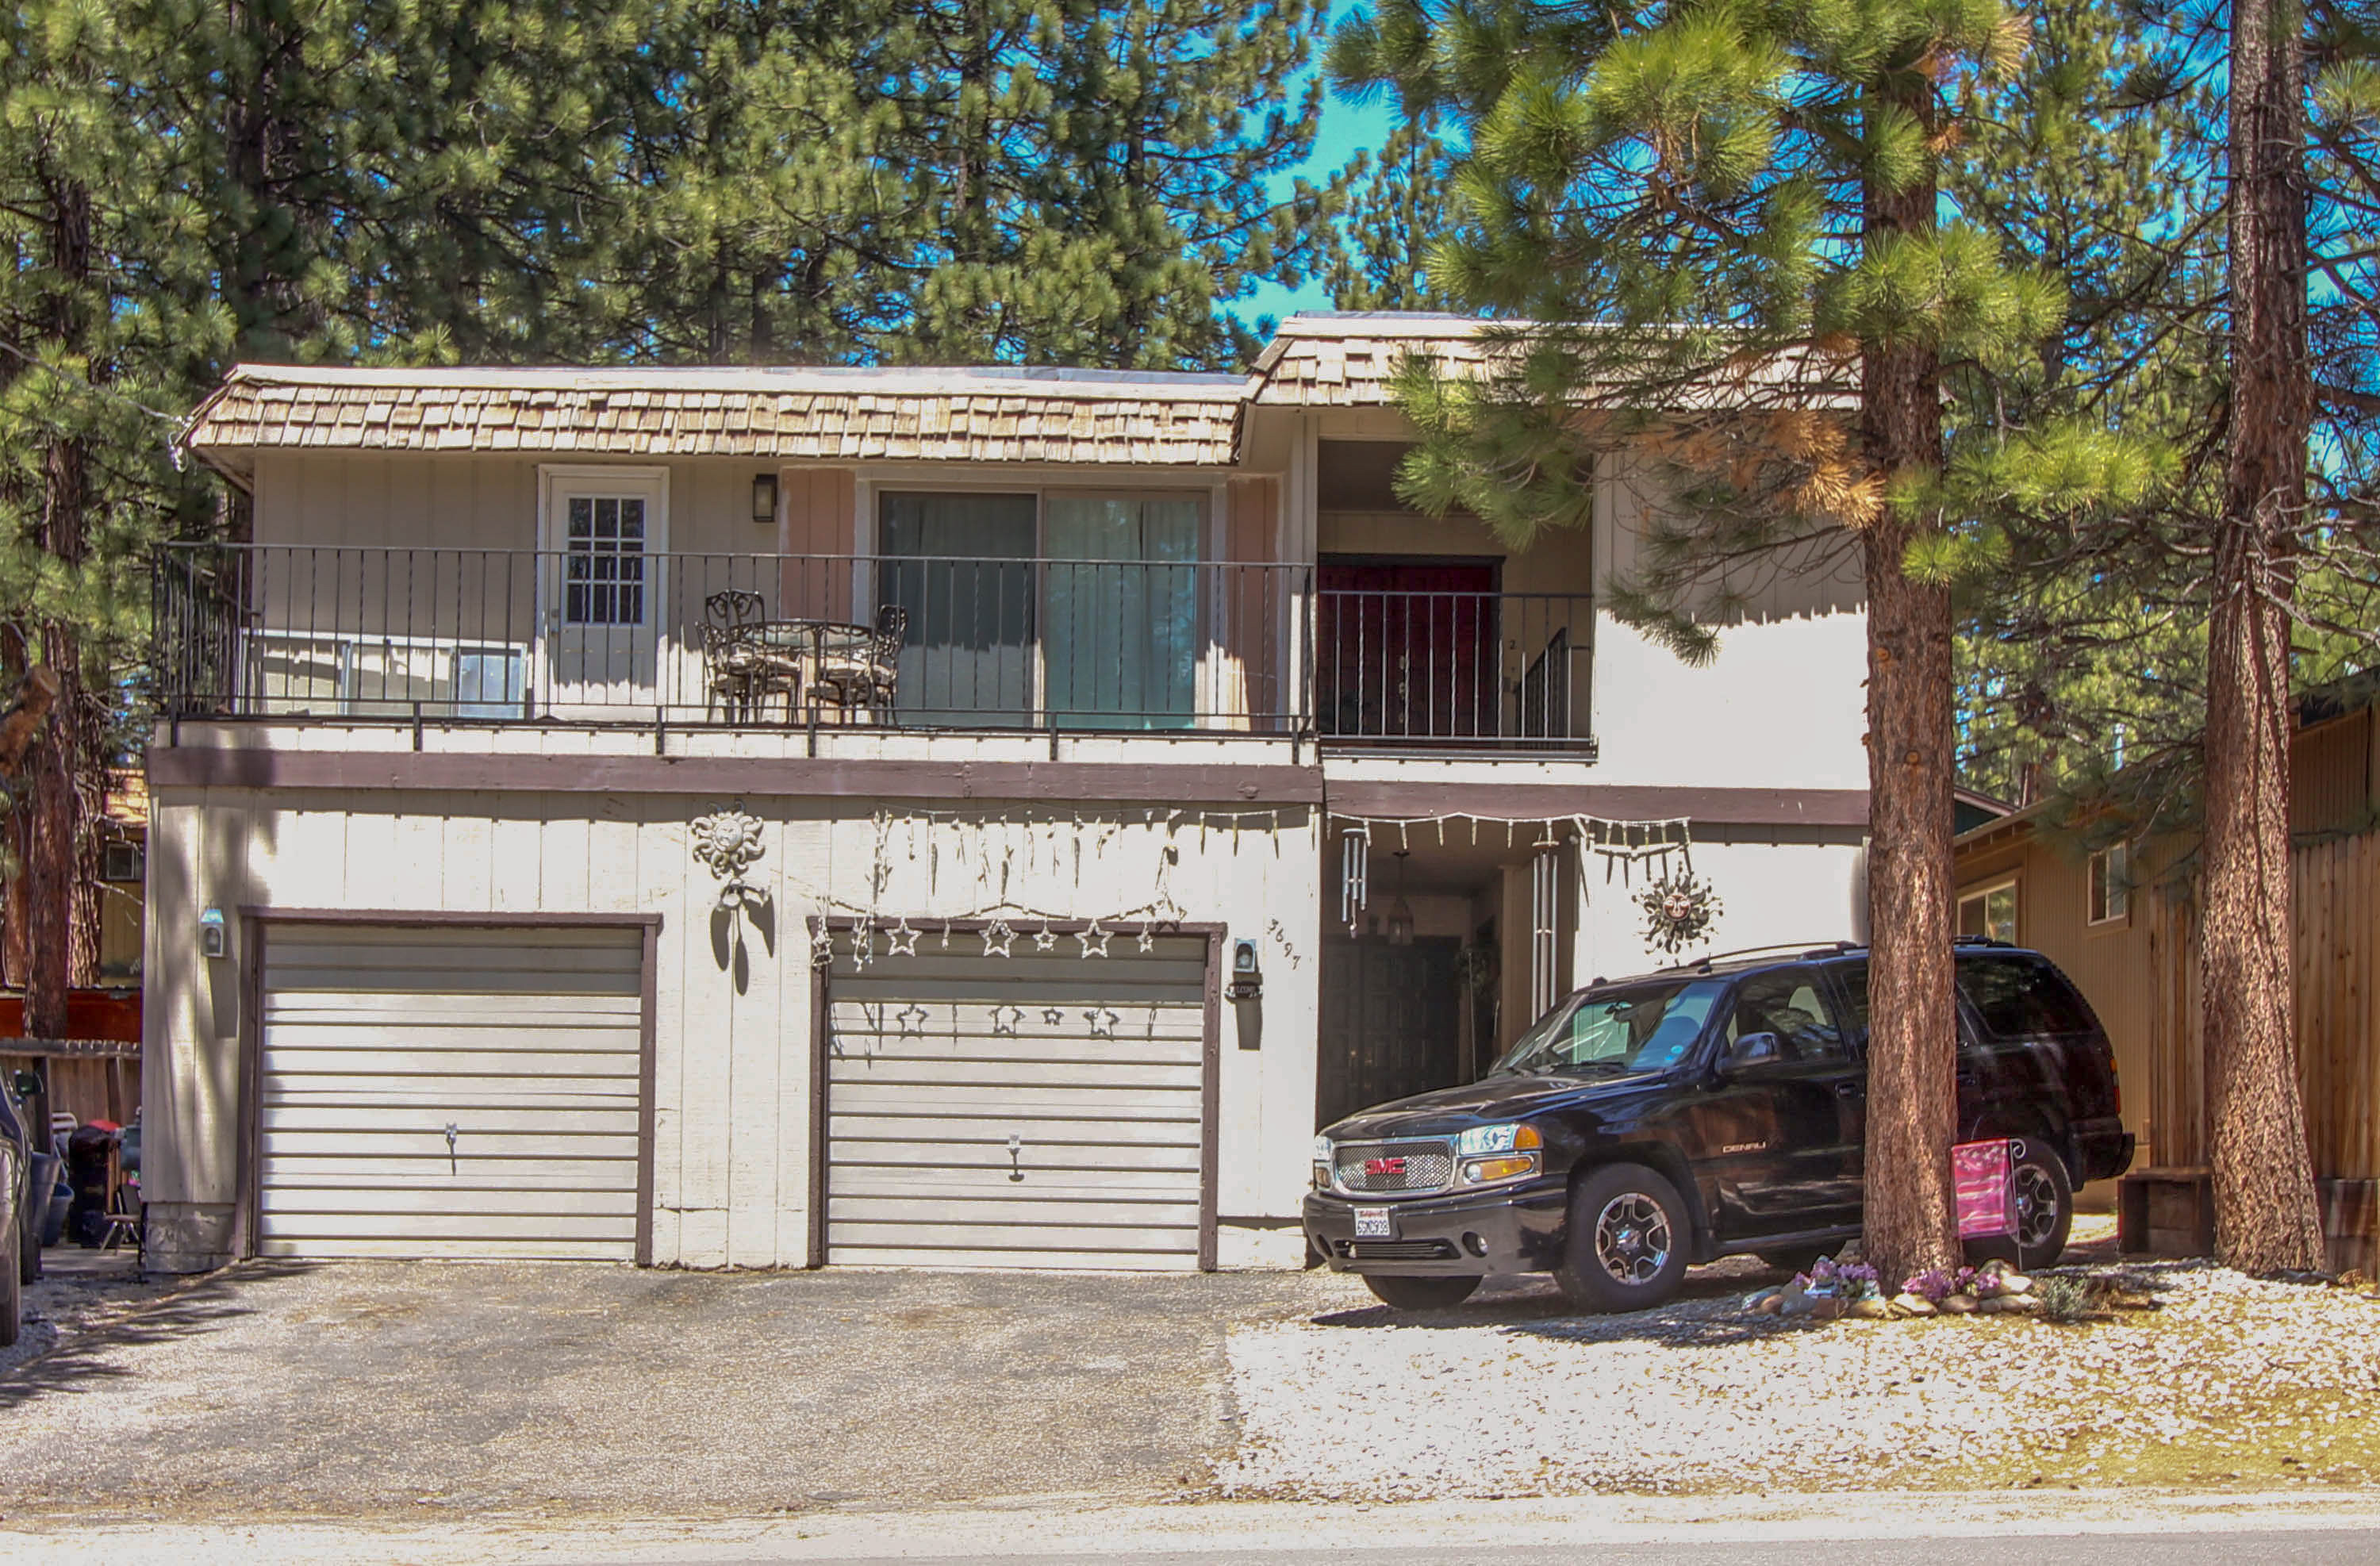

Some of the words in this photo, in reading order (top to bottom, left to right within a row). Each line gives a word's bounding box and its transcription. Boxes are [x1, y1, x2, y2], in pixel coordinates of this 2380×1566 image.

[1267, 918, 1302, 970] 3697
[1722, 1141, 1766, 1153] DENALI
[1365, 1157, 1406, 1175] GMC
